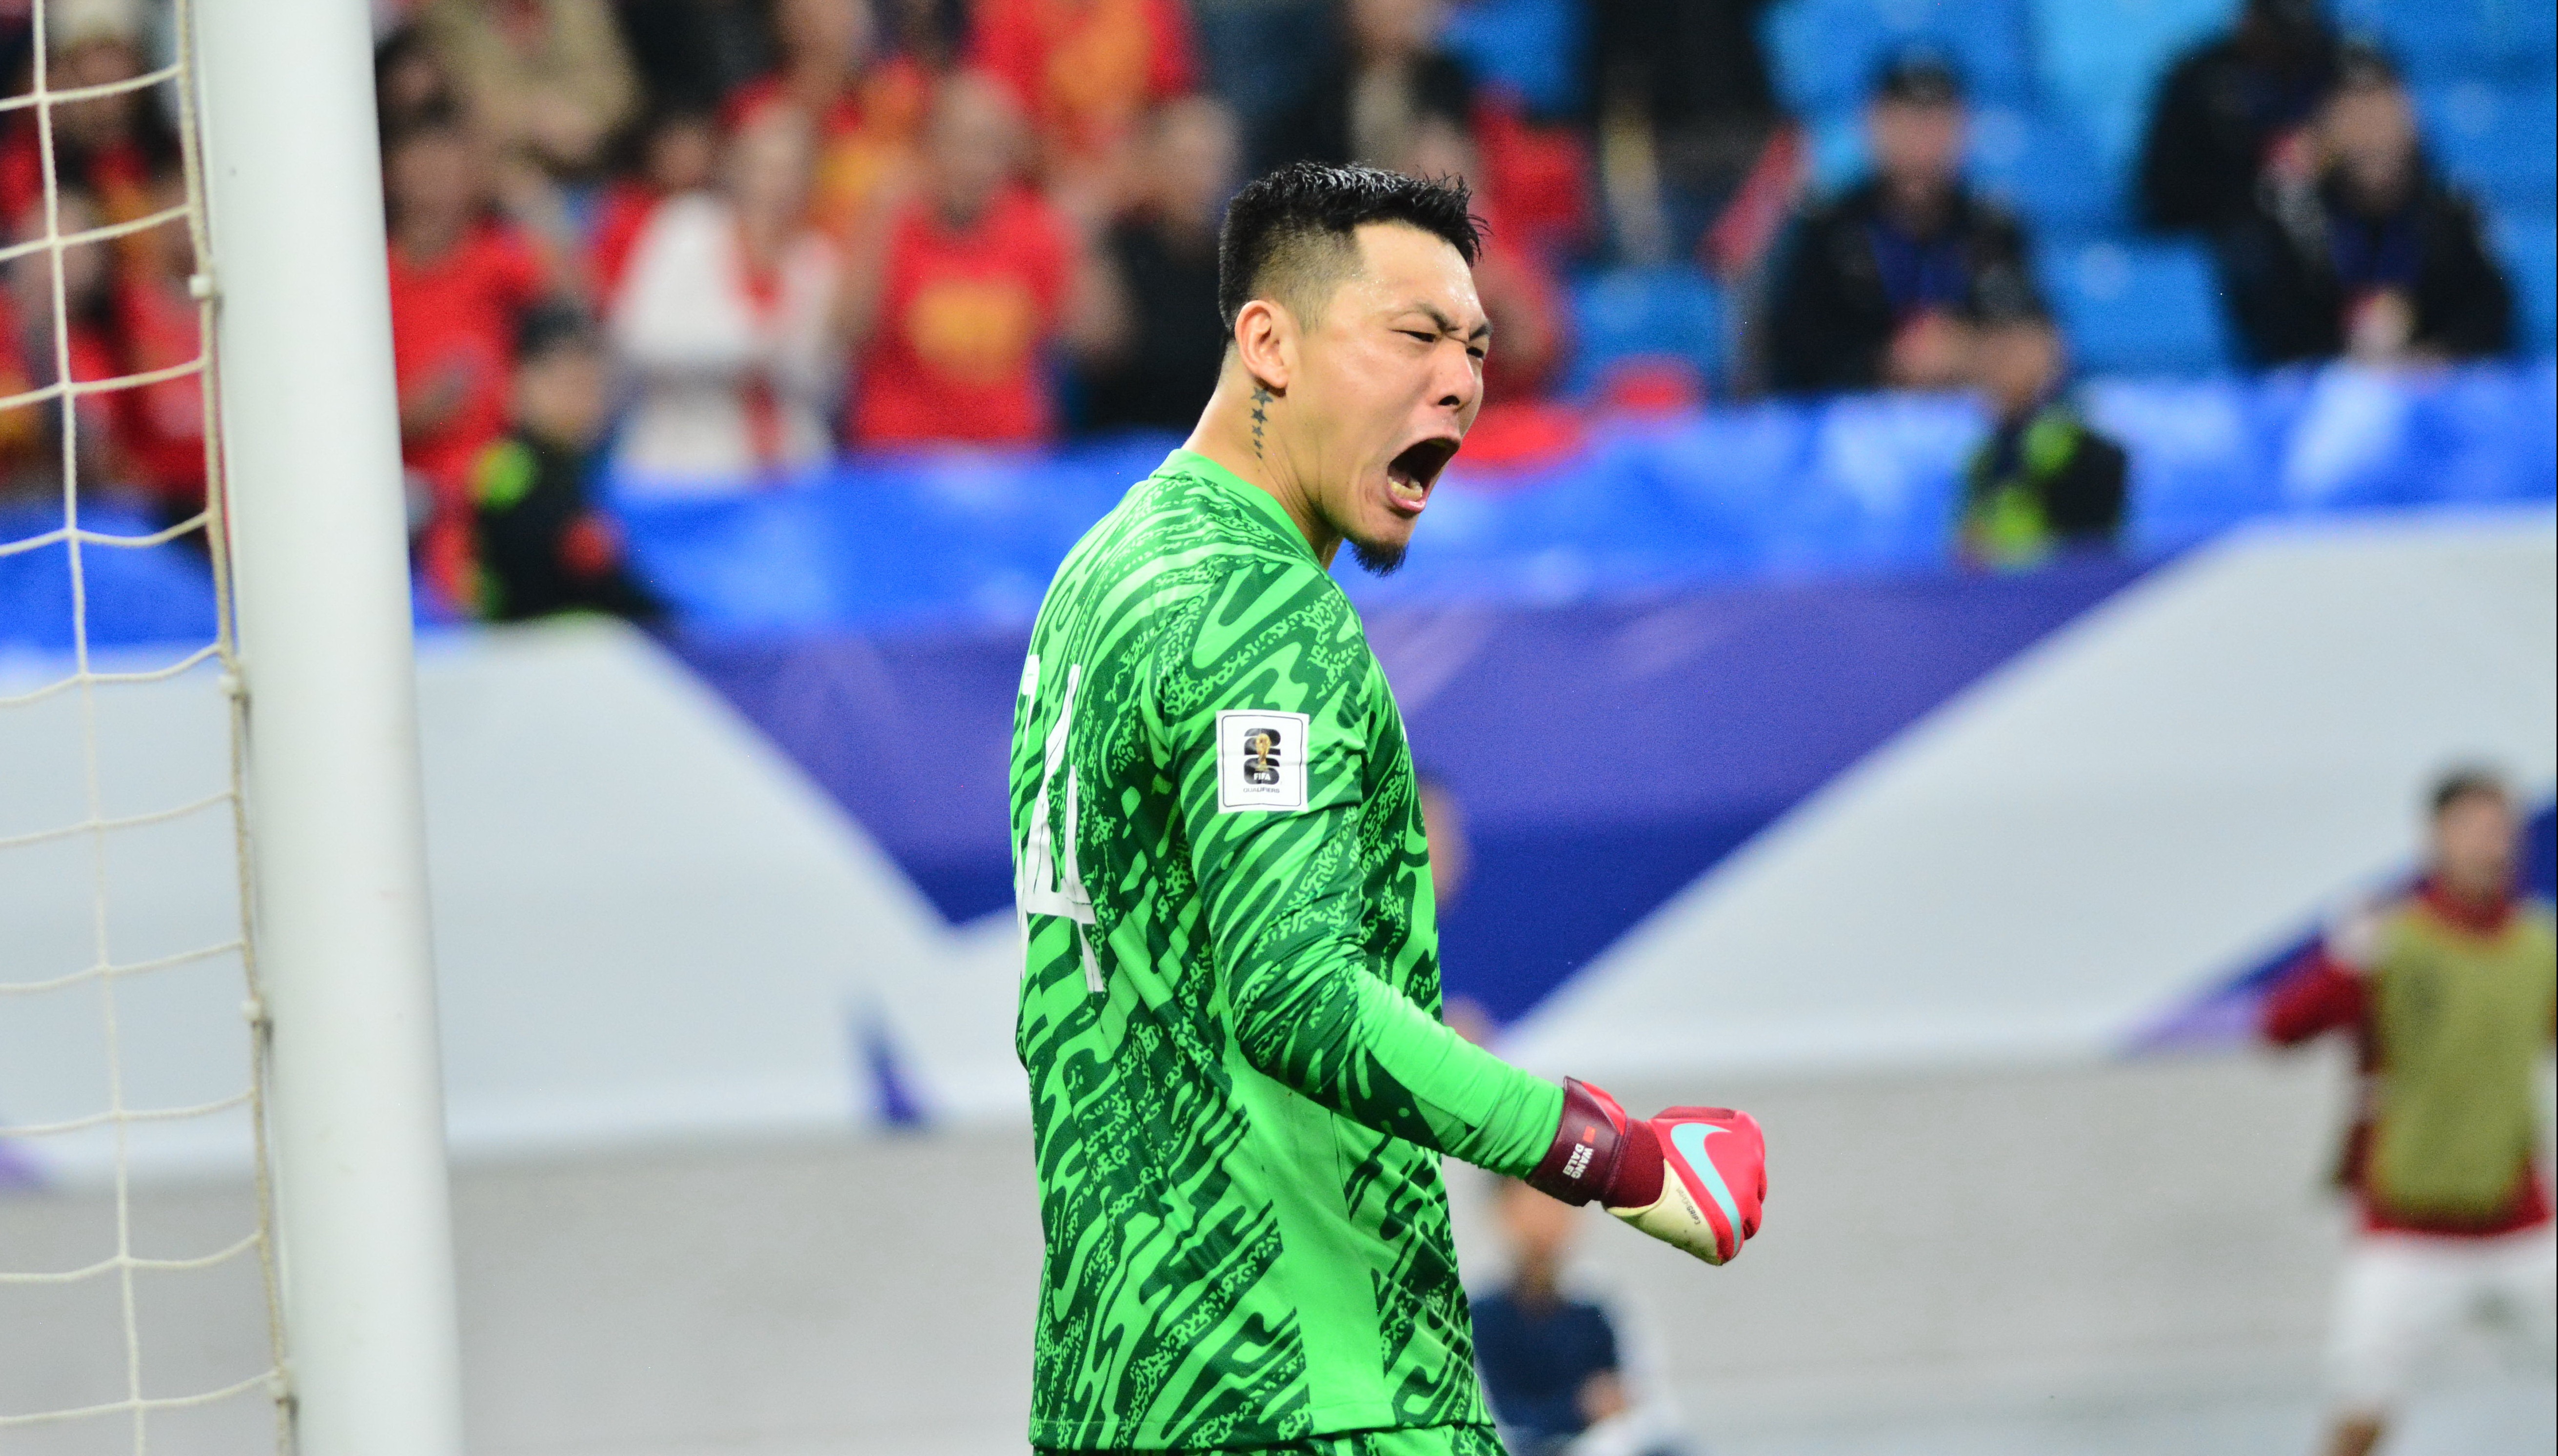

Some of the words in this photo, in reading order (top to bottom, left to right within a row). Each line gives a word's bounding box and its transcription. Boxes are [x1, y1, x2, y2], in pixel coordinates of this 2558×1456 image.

[1254, 772, 1271, 781] FIFA
[1563, 1143, 1585, 1176] DALEI
[1571, 1148, 1594, 1179] WANG
